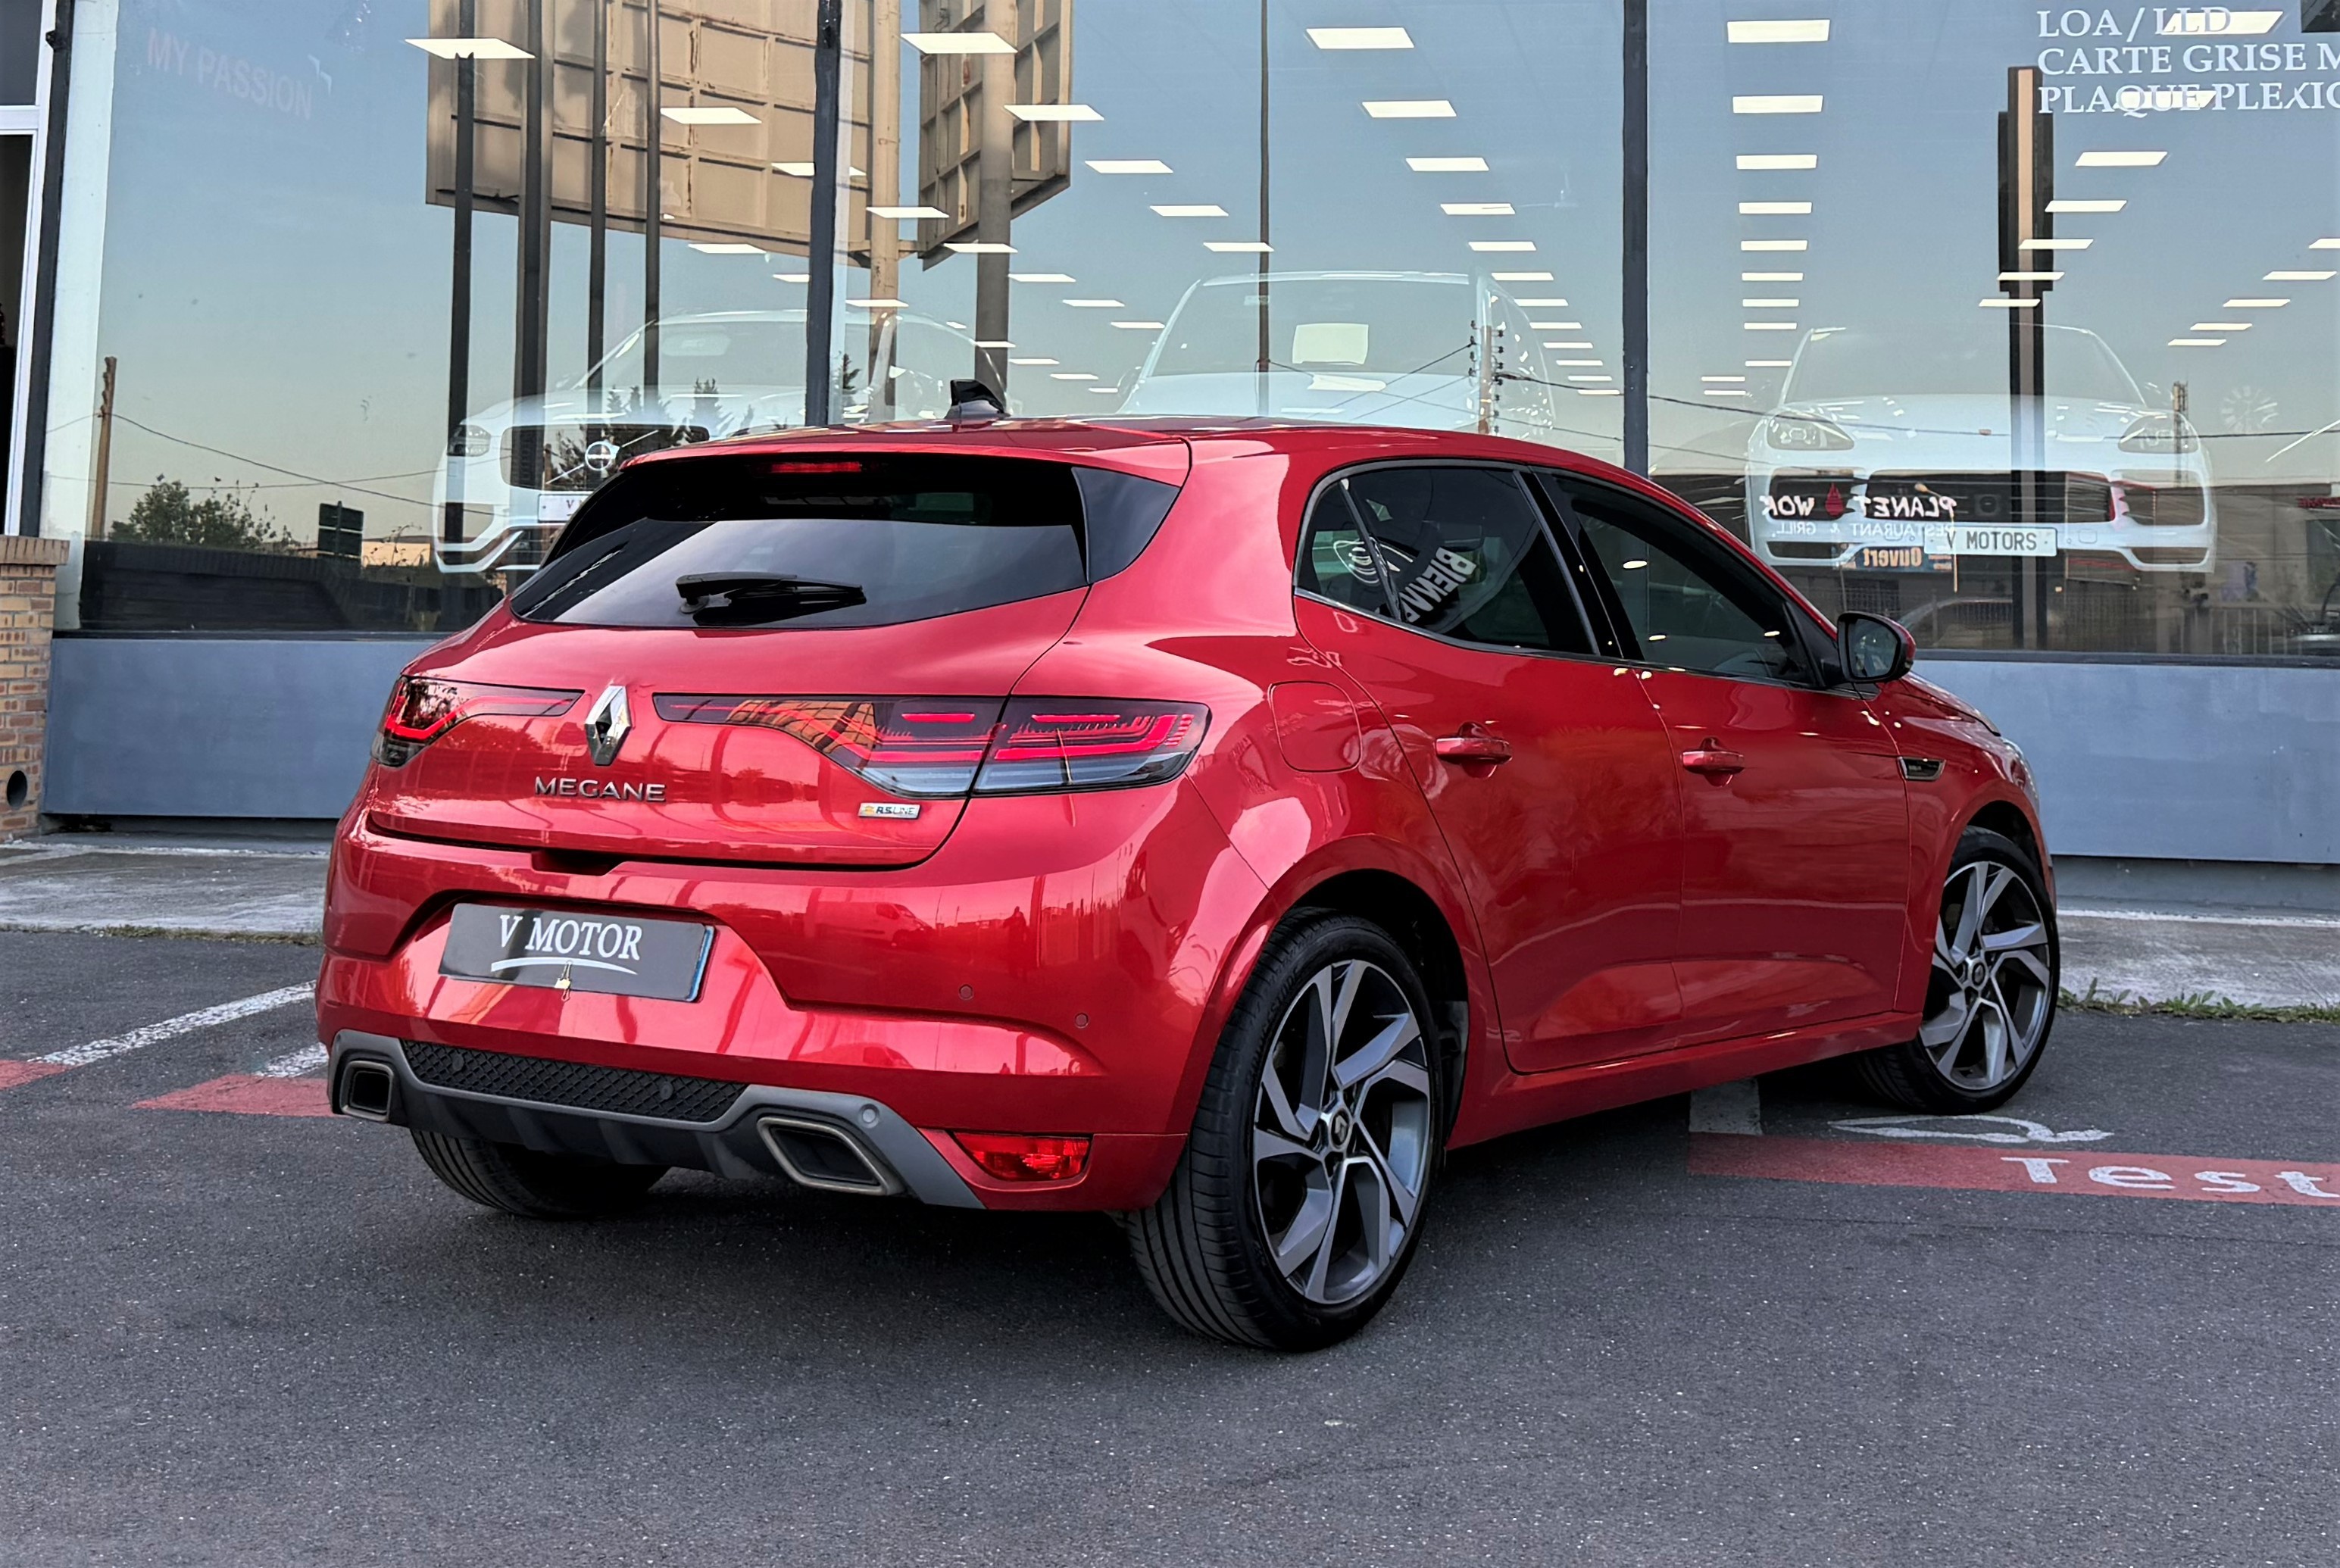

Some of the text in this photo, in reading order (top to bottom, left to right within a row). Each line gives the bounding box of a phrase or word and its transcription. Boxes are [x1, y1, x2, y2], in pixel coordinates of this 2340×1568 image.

[148, 26, 313, 121] MY PASSION
[2037, 46, 2173, 76] CARTE
[2182, 43, 2307, 73] GRISE
[2038, 84, 2201, 118] PLAQUE
[1966, 530, 2038, 551] MOTORS
[535, 776, 667, 803] MEGANE
[499, 914, 643, 961] V MOTOR
[2000, 1156, 2339, 1200] Test
